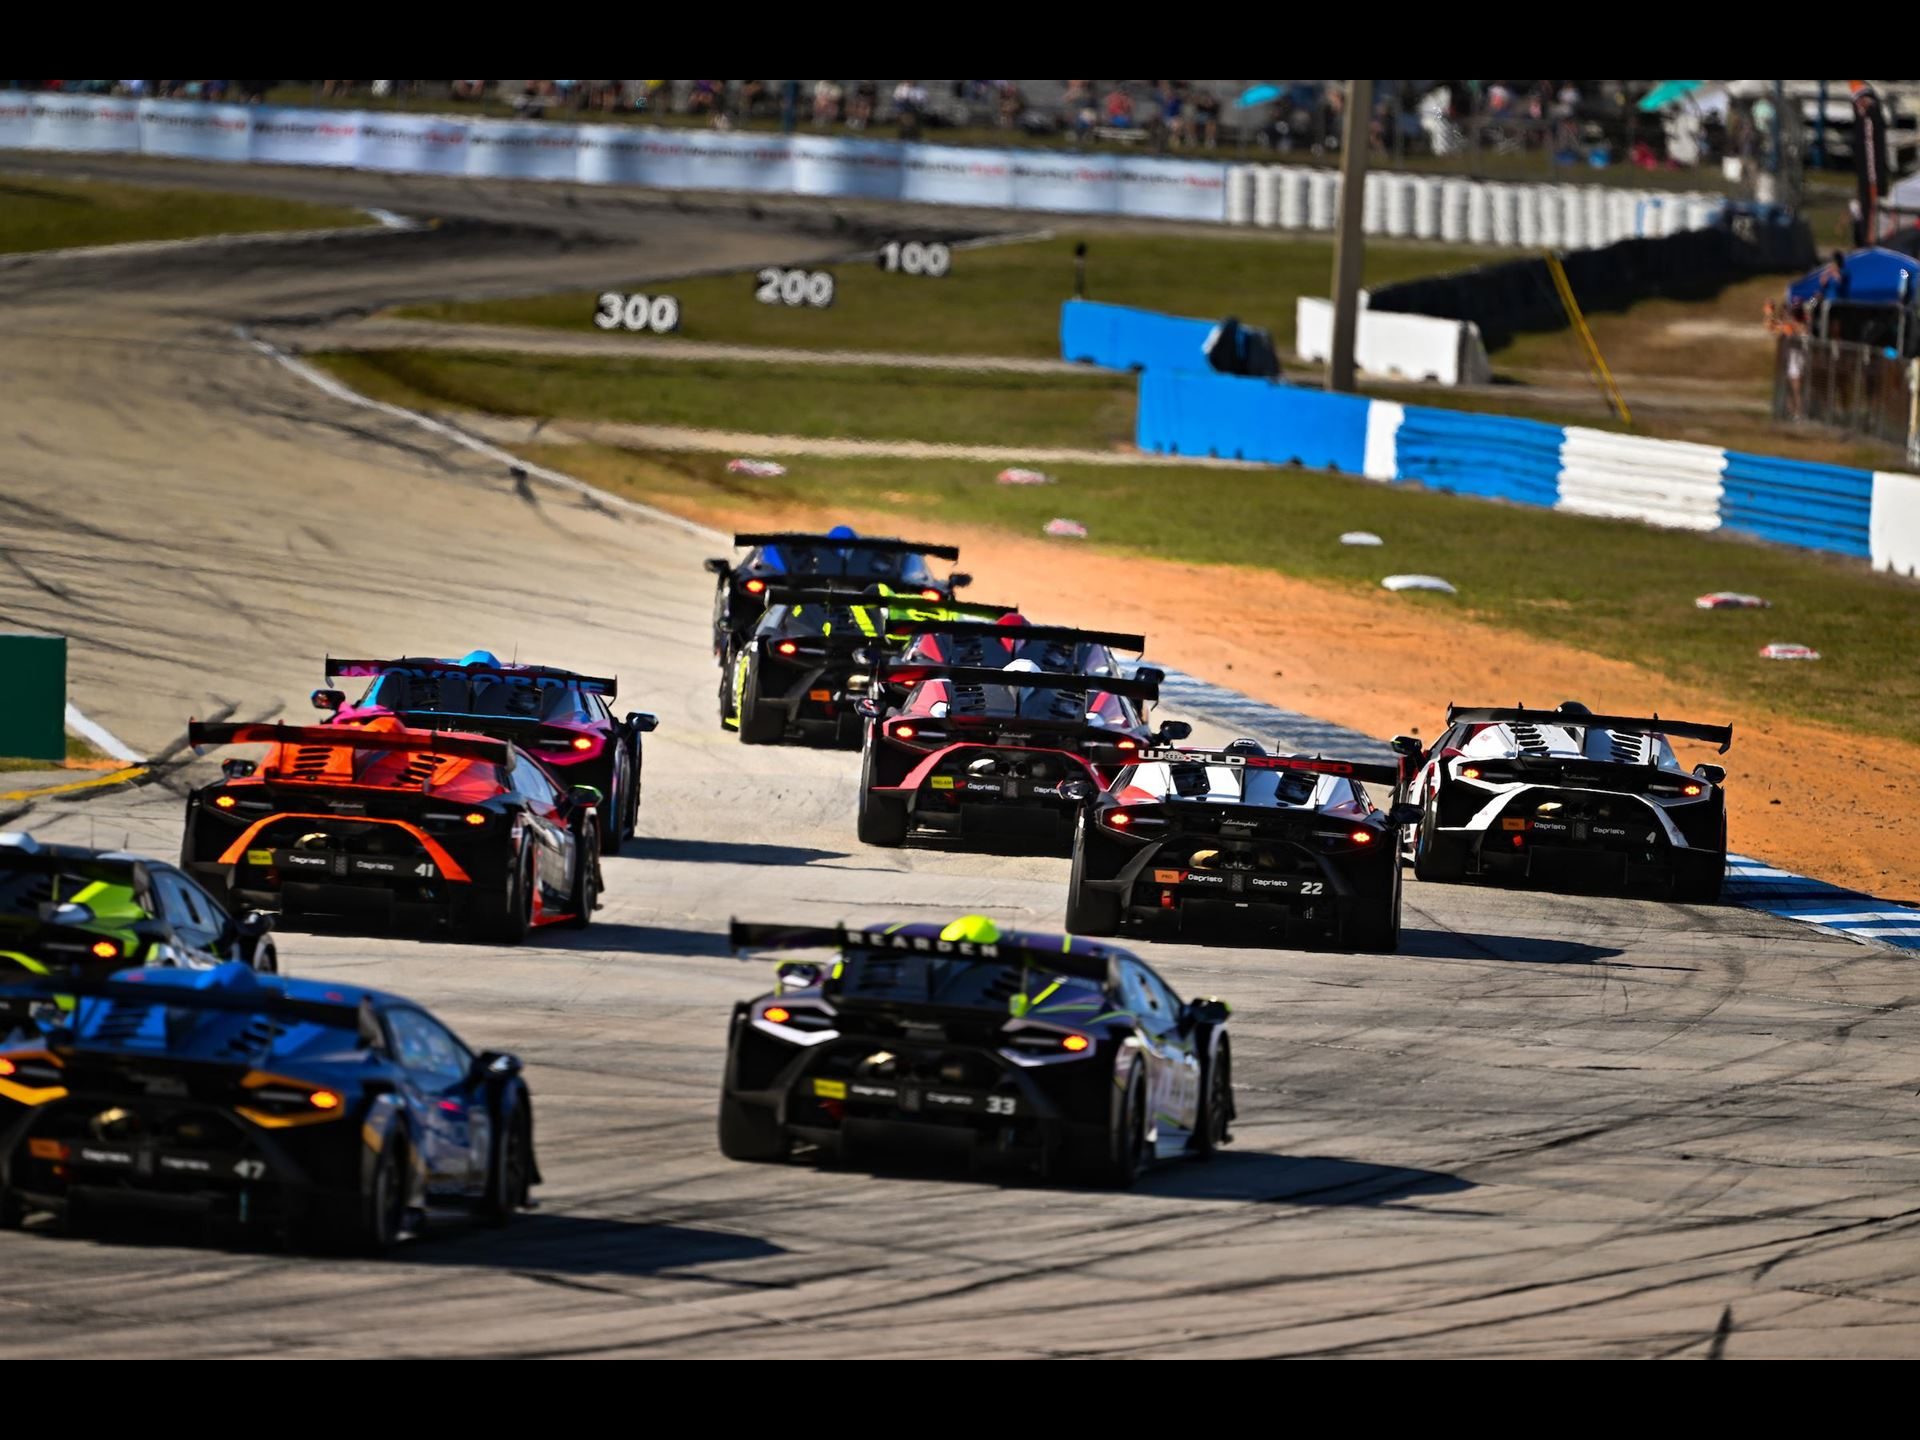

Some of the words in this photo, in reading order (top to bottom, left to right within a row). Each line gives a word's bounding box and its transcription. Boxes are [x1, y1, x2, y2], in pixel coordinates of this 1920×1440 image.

[880, 241, 950, 277] 100
[756, 267, 834, 307] 200
[594, 291, 680, 333] 300
[1646, 831, 1657, 844] 4
[414, 863, 435, 878] 41
[1187, 873, 1223, 883] Capristo
[1252, 878, 1288, 887] Capristo
[1300, 881, 1324, 895] 22
[847, 932, 999, 958] REARDEN
[985, 1095, 1016, 1115] 33
[233, 1158, 266, 1180] 47
